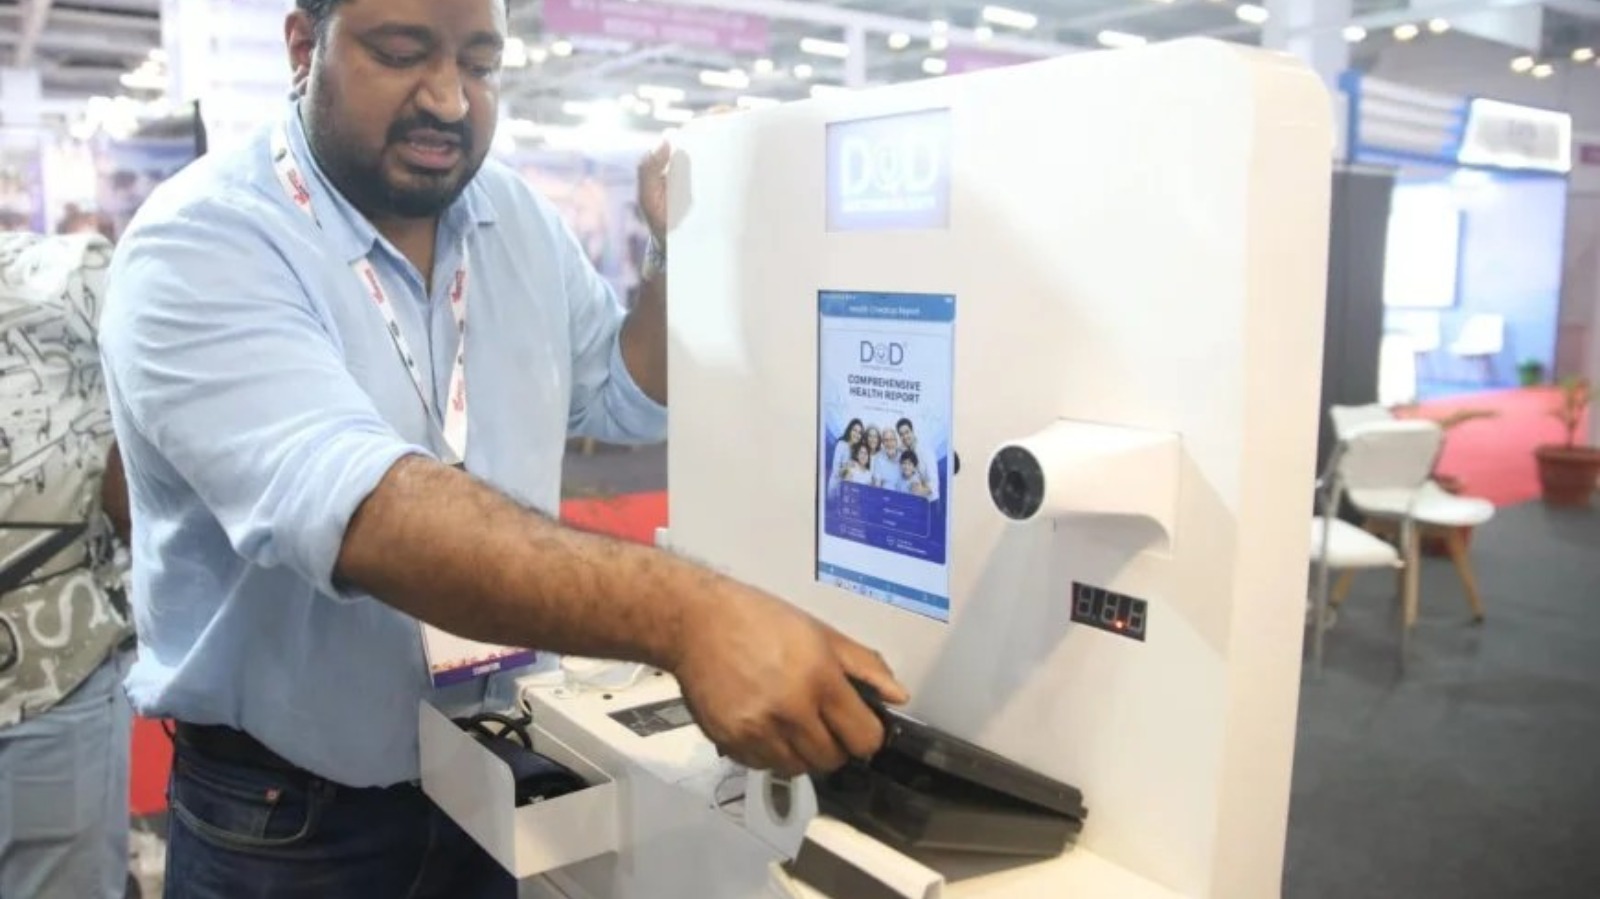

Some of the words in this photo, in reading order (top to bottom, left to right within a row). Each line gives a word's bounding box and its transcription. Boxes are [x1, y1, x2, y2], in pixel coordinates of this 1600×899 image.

[847, 374, 921, 392] COMPREHENSIVE
[849, 386, 883, 400] HEALTH
[884, 390, 921, 404] REPORT
